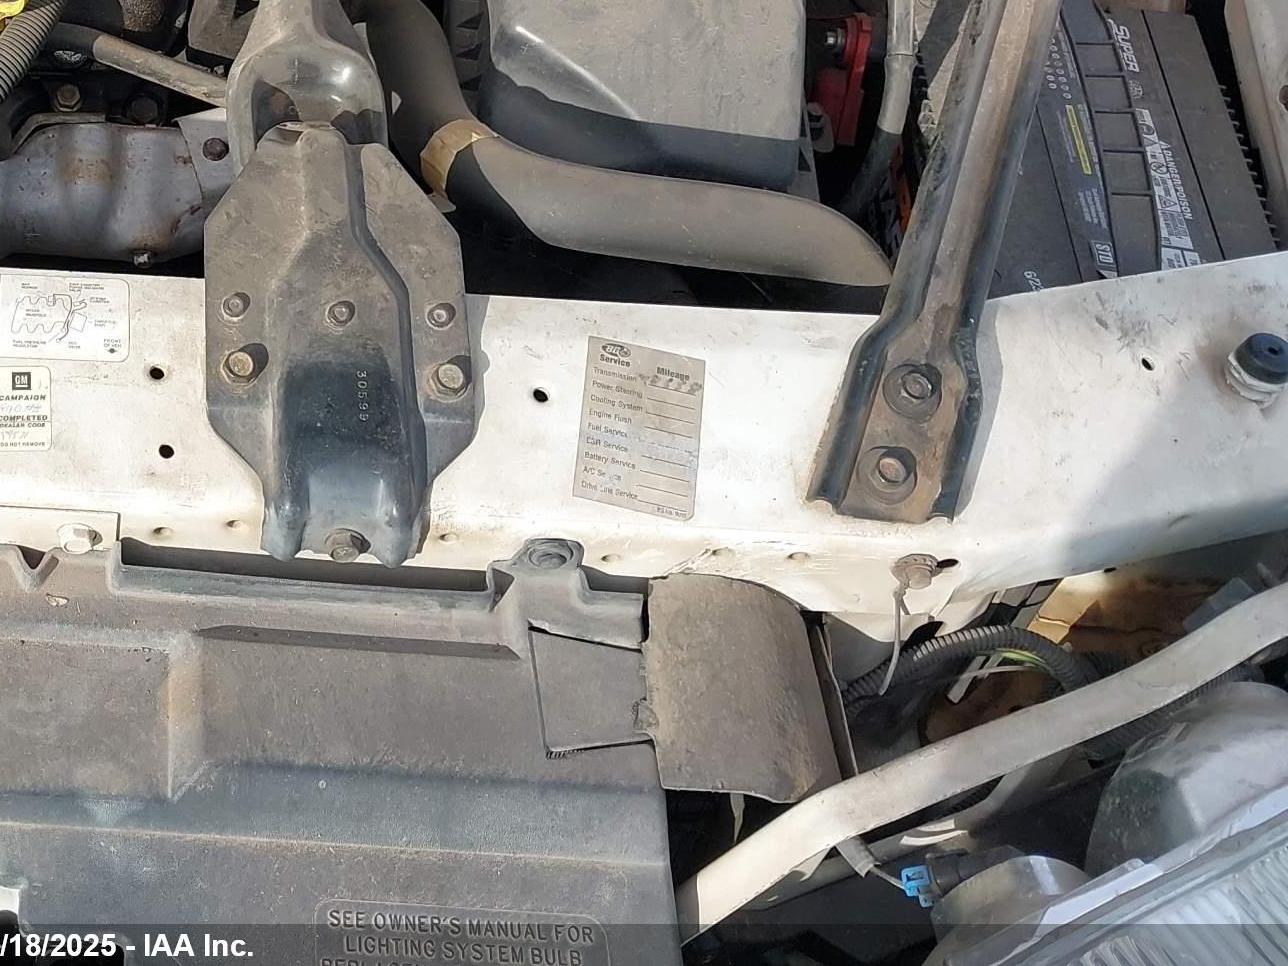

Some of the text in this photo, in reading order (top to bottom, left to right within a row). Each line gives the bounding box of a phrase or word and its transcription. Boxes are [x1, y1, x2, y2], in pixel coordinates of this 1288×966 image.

[1113, 24, 1140, 74] SUPER
[599, 353, 631, 368] Service
[13, 373, 30, 389] GM
[592, 366, 638, 382] Transmission
[656, 366, 690, 382] Mileage
[356, 370, 370, 421] 30599
[591, 379, 643, 399] Power Steering
[590, 393, 644, 413] Cooling System
[588, 408, 632, 425] Engine Flush
[587, 421, 603, 432] Fuel
[602, 440, 629, 453] Service
[584, 450, 636, 470] Battery Service
[582, 465, 597, 476] A/C
[615, 488, 640, 501] Service
[327, 910, 594, 944] SEE OWNER'S MANUAL FOR
[343, 935, 582, 966] LIGHTING SYSTEM BULB
